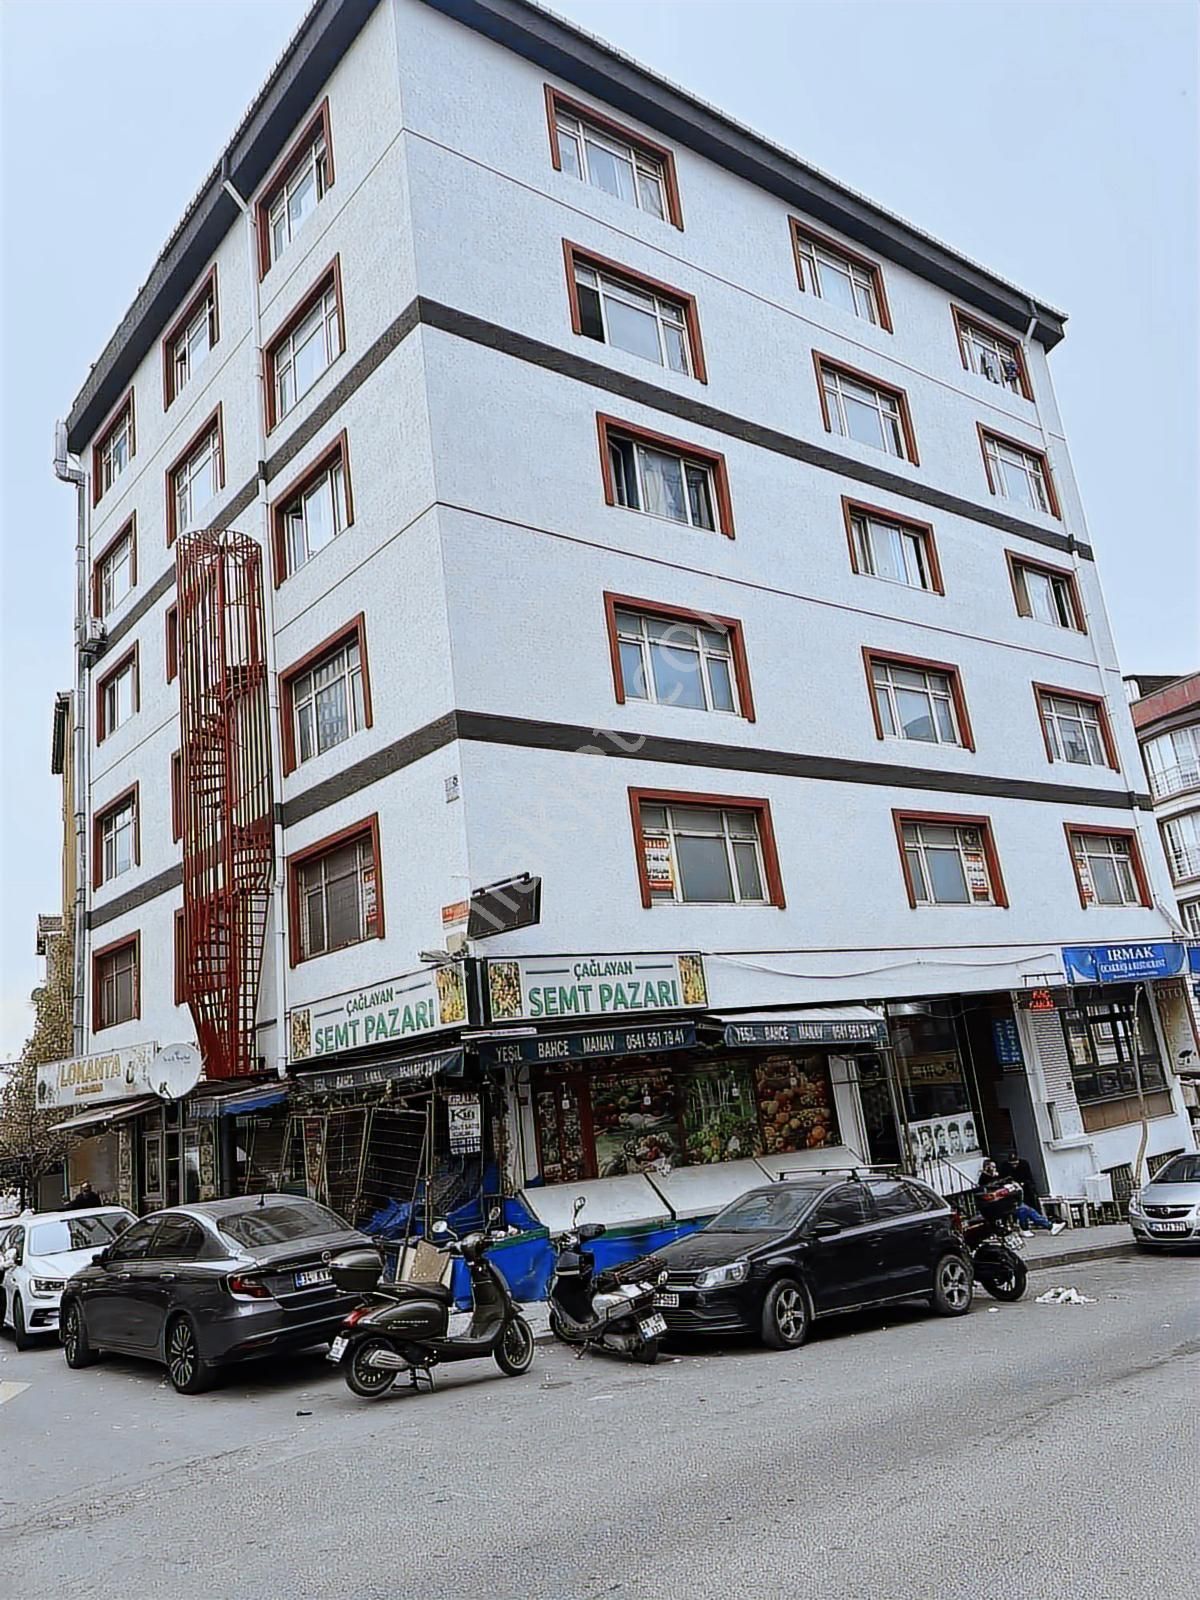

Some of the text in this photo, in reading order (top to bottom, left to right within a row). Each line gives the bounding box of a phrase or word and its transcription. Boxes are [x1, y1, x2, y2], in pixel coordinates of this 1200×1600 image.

[1107, 946, 1155, 961] IRMAK
[573, 959, 634, 981] ÇAĞLAYAN
[346, 987, 395, 1016] ÇAĞLAYAN
[529, 979, 679, 1017] SEMT PAZARI
[314, 998, 436, 1055] SEMT PAZARI
[59, 1053, 121, 1089] LOKANTA
